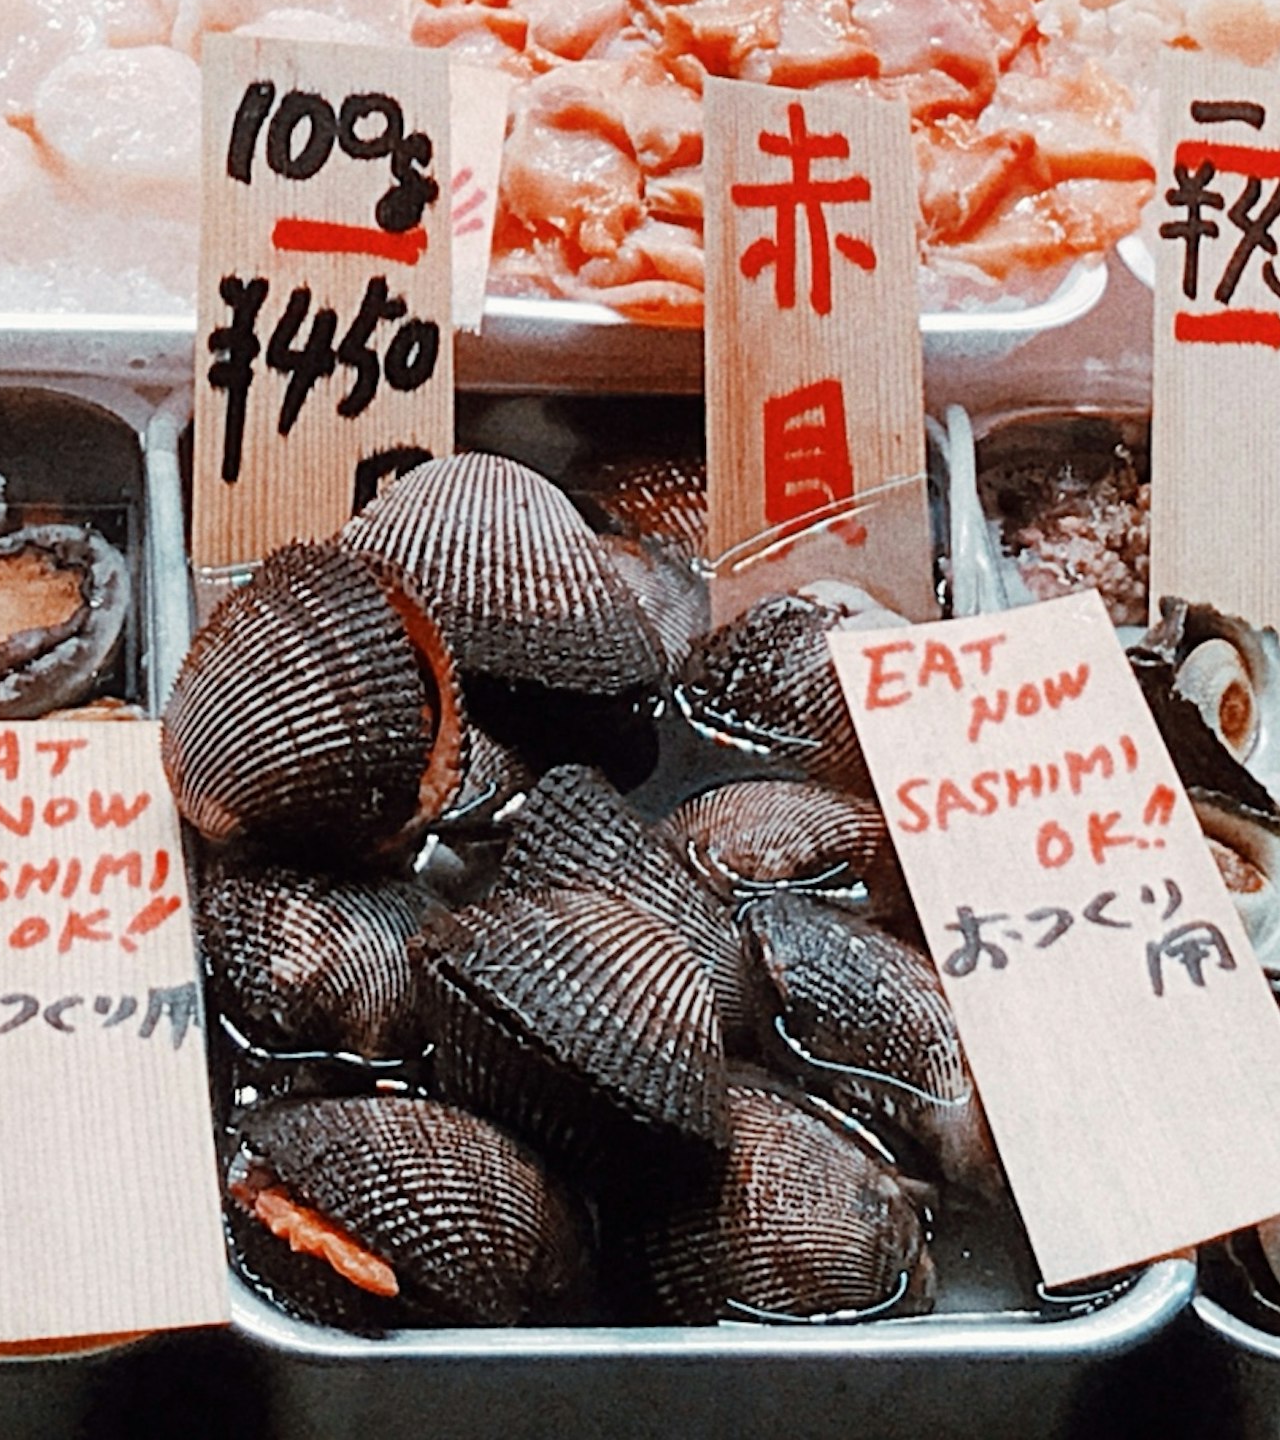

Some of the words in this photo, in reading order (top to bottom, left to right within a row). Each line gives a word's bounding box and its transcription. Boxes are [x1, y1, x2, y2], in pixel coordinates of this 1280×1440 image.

[226, 79, 440, 233] 100g
[207, 274, 440, 485] ¥450
[730, 101, 877, 563] 赤貝
[862, 633, 1007, 711] EAT
[968, 663, 1091, 743] NOW
[894, 734, 1139, 834] SASHIMI
